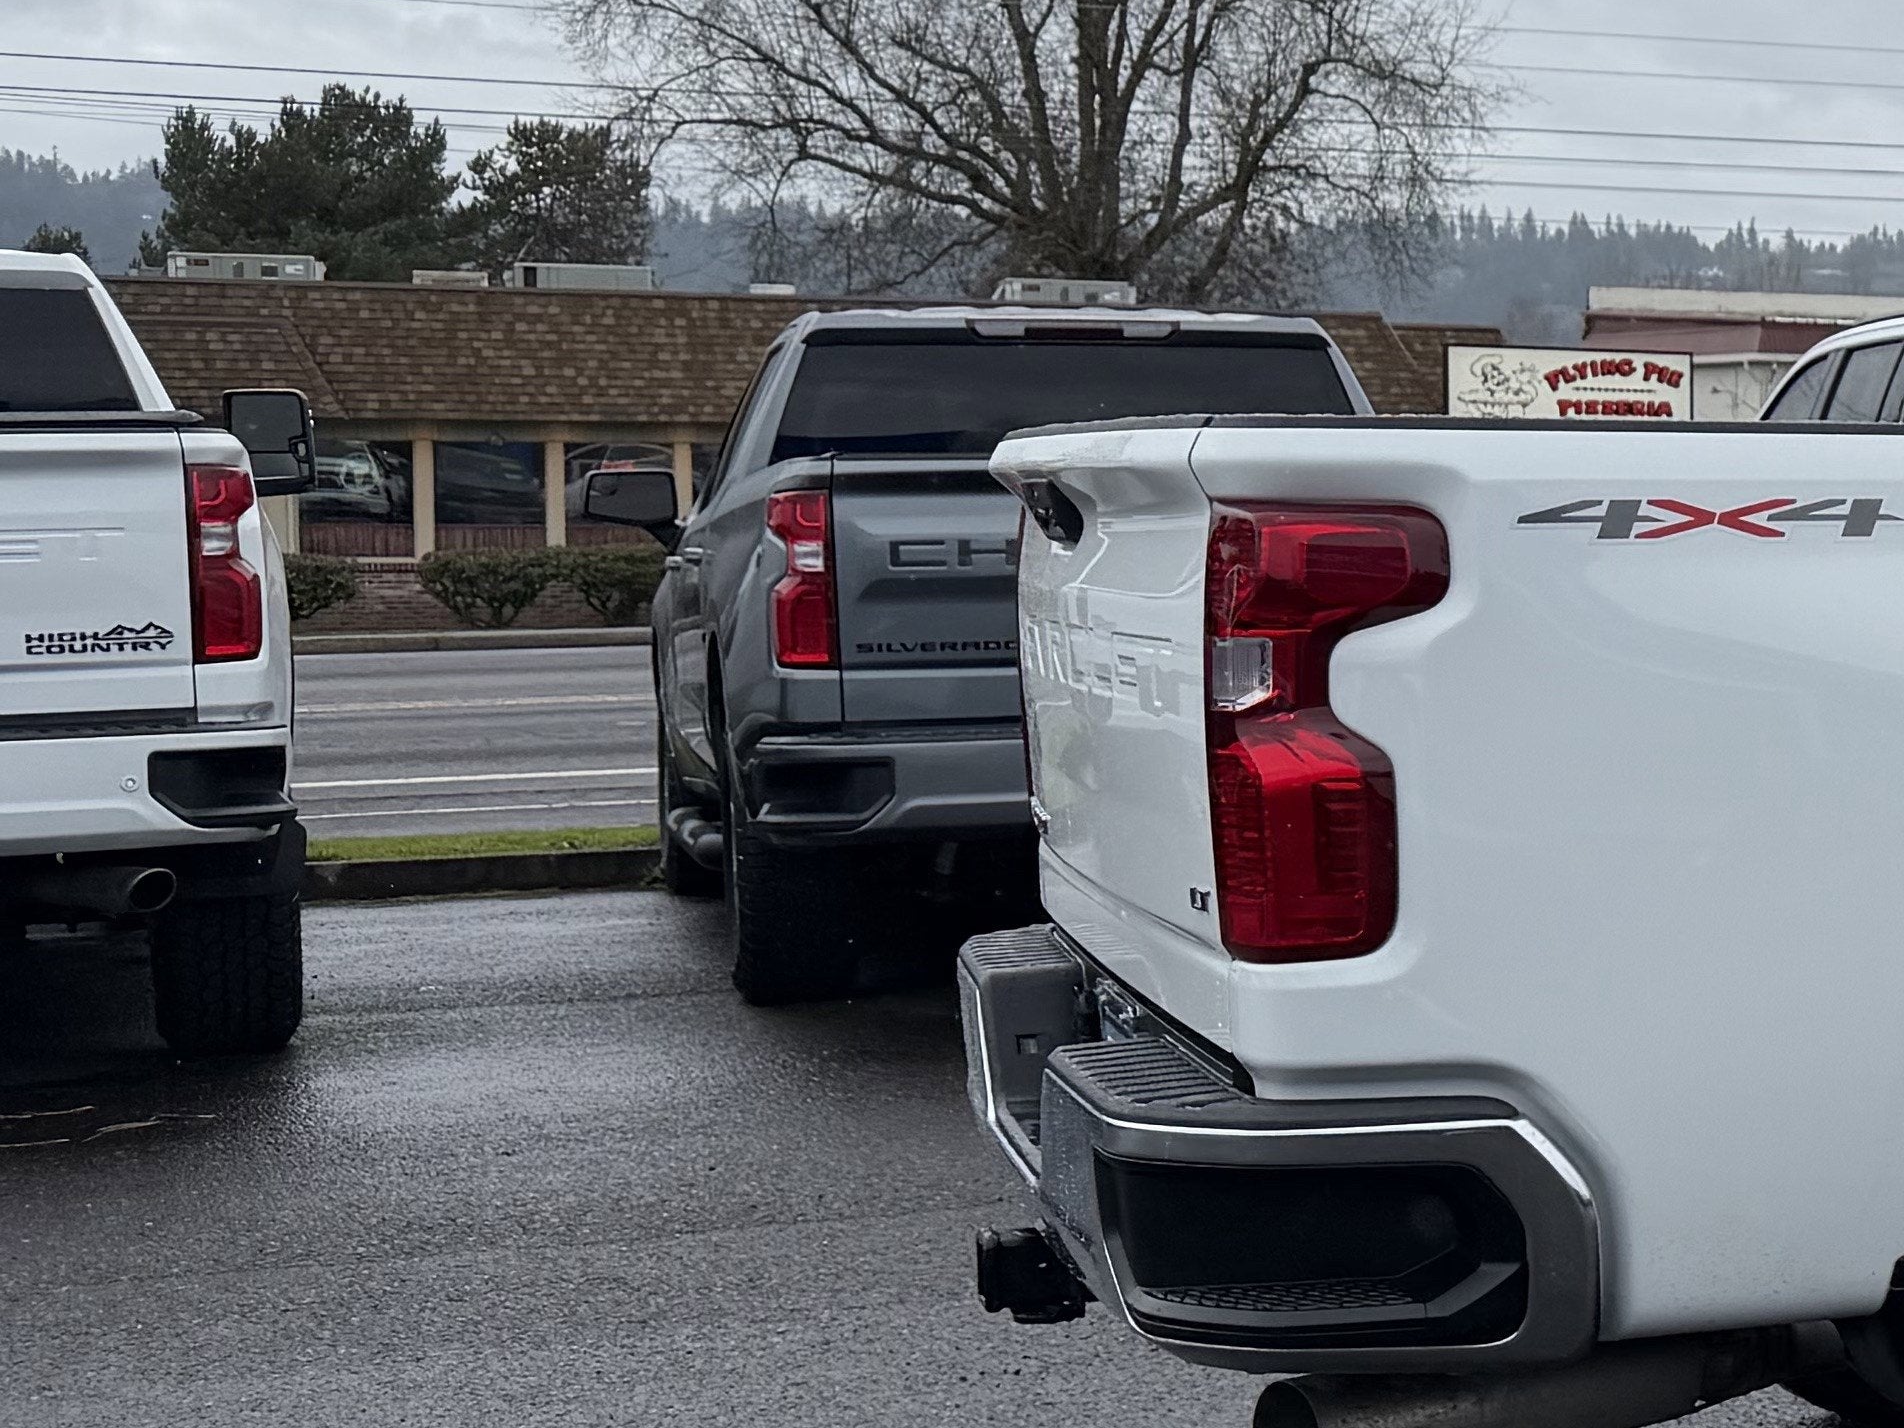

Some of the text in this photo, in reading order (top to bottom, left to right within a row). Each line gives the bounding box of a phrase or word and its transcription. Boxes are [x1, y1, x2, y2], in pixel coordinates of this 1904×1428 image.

[1544, 358, 1684, 392] FLYING PIE
[1557, 399, 1673, 417] PIZZERIA
[25, 631, 101, 644] HIGH
[26, 639, 174, 655] COUNTRY
